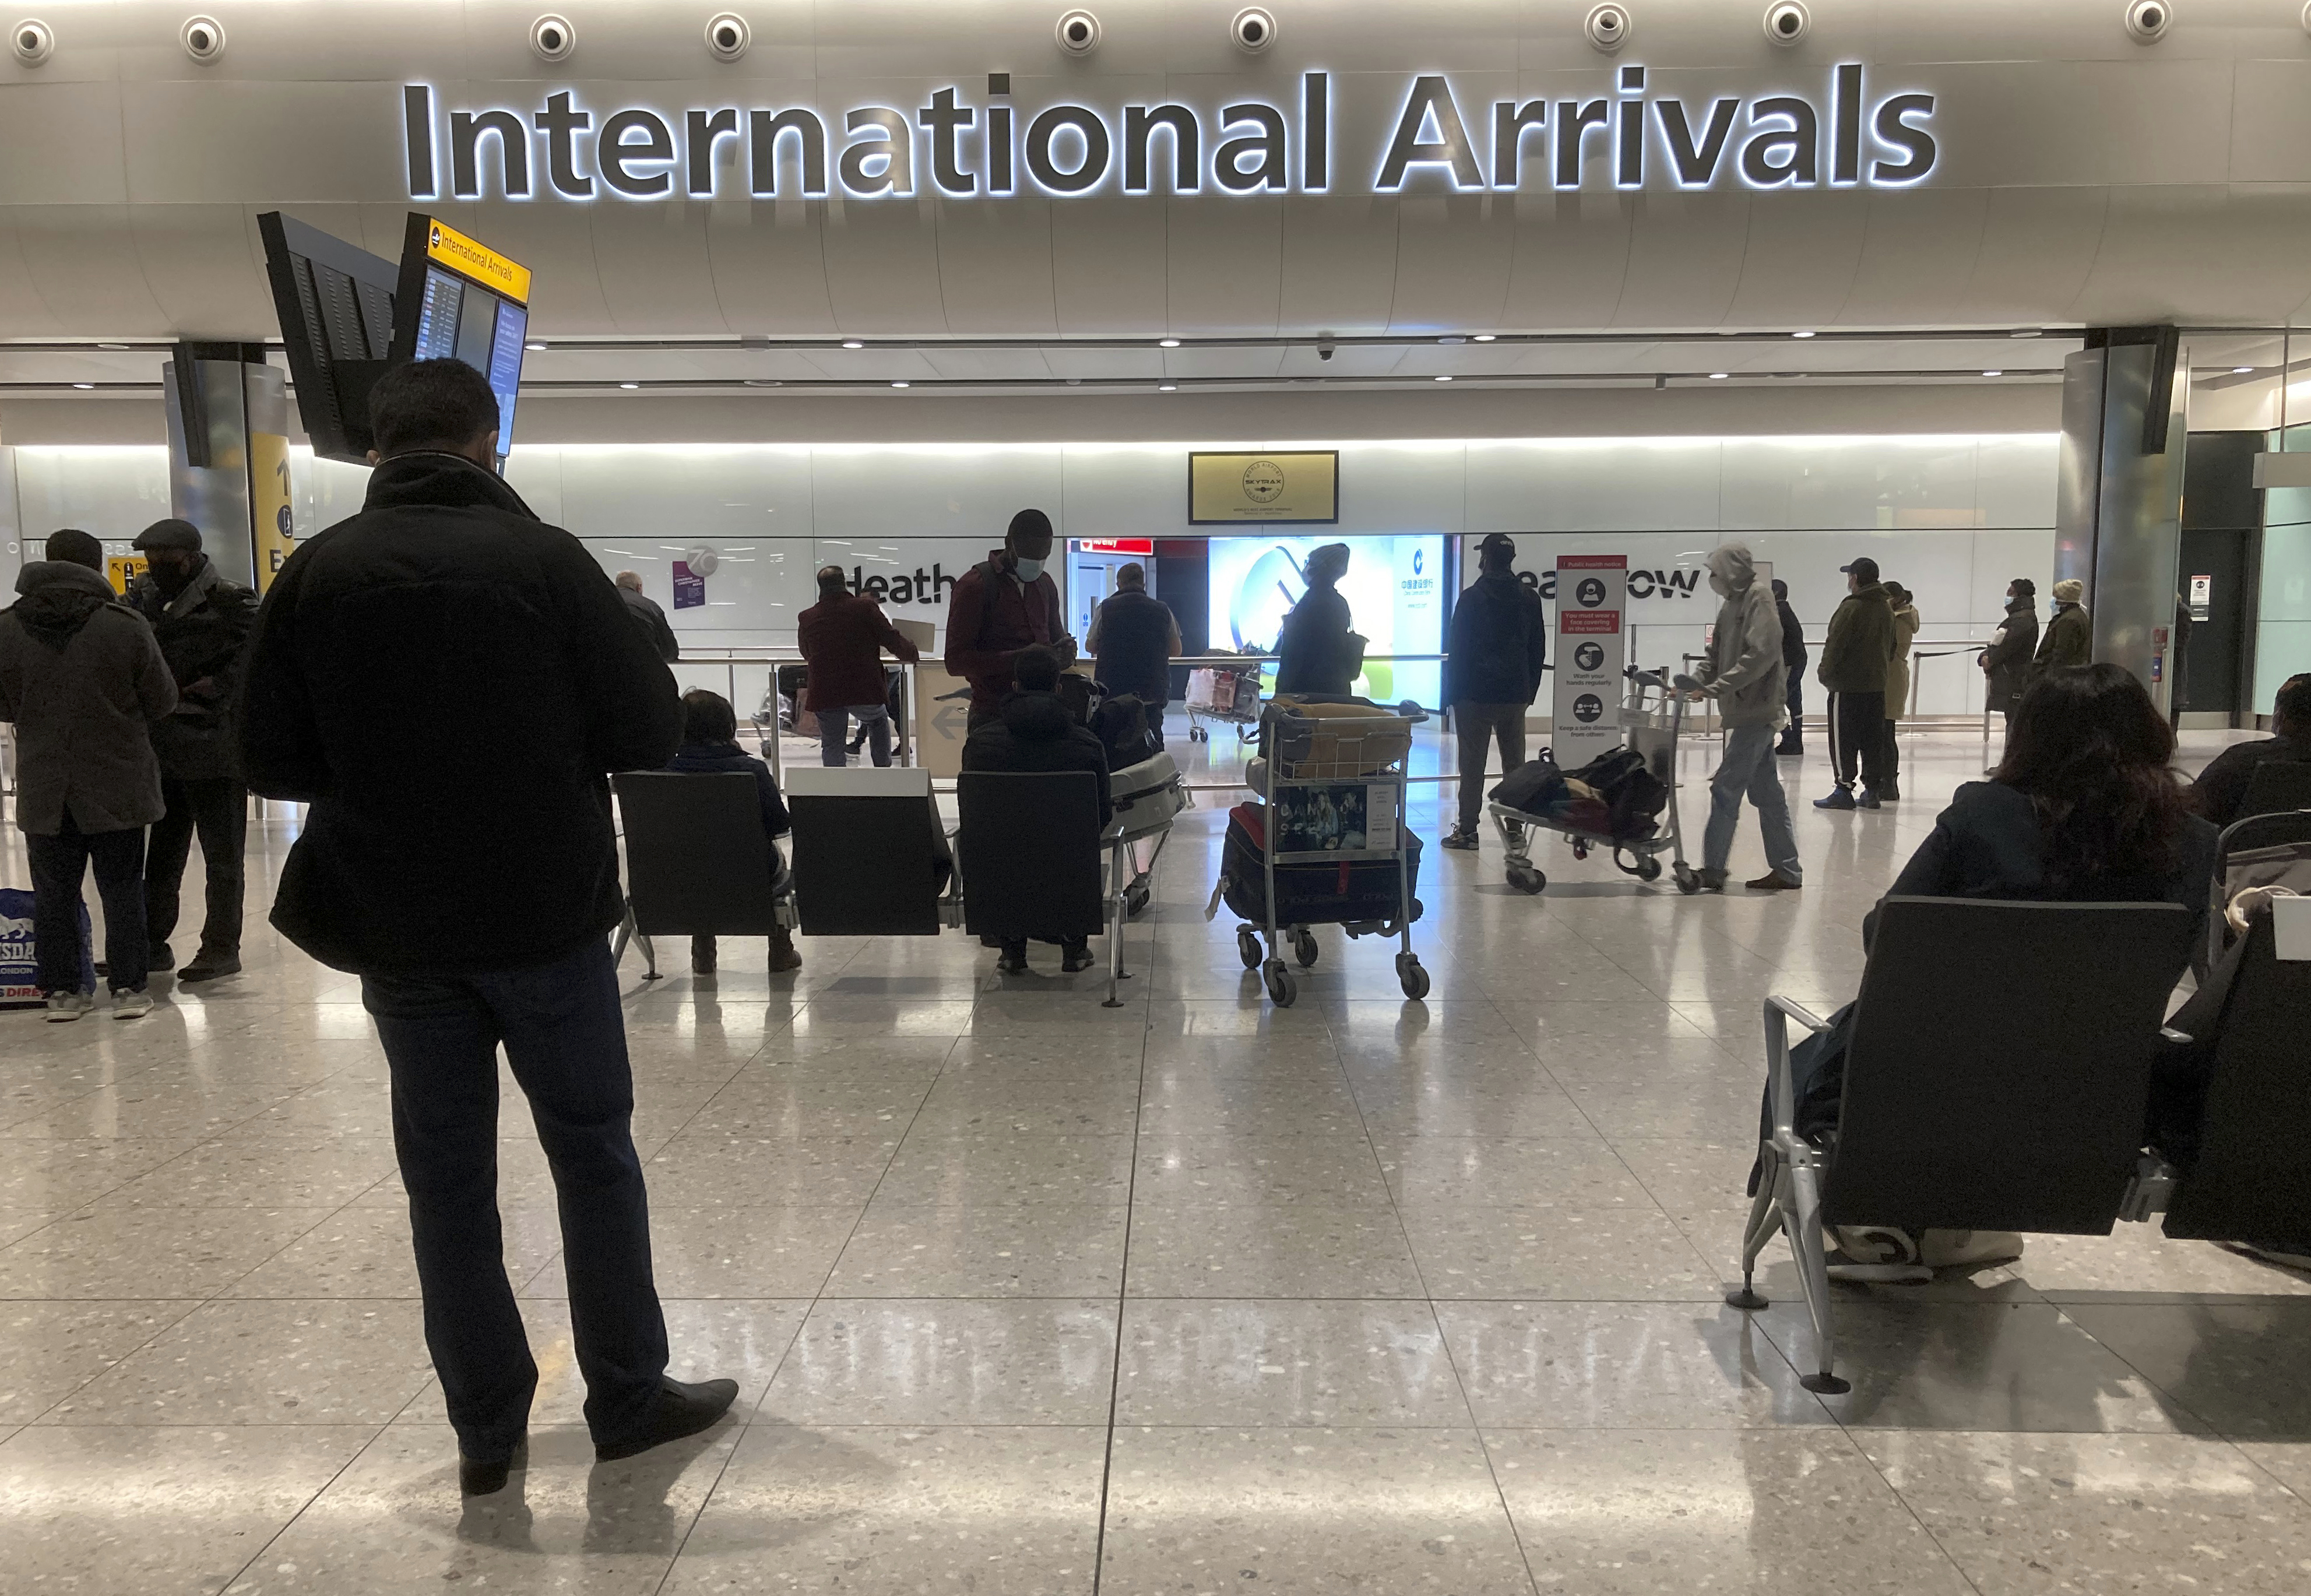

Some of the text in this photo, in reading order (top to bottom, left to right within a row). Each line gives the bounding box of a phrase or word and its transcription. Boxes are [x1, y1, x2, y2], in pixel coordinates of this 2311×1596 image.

[403, 64, 1937, 198] International Arrivals
[442, 233, 512, 282] International Arrivals
[1246, 463, 1281, 478] WORLD AIRPORT
